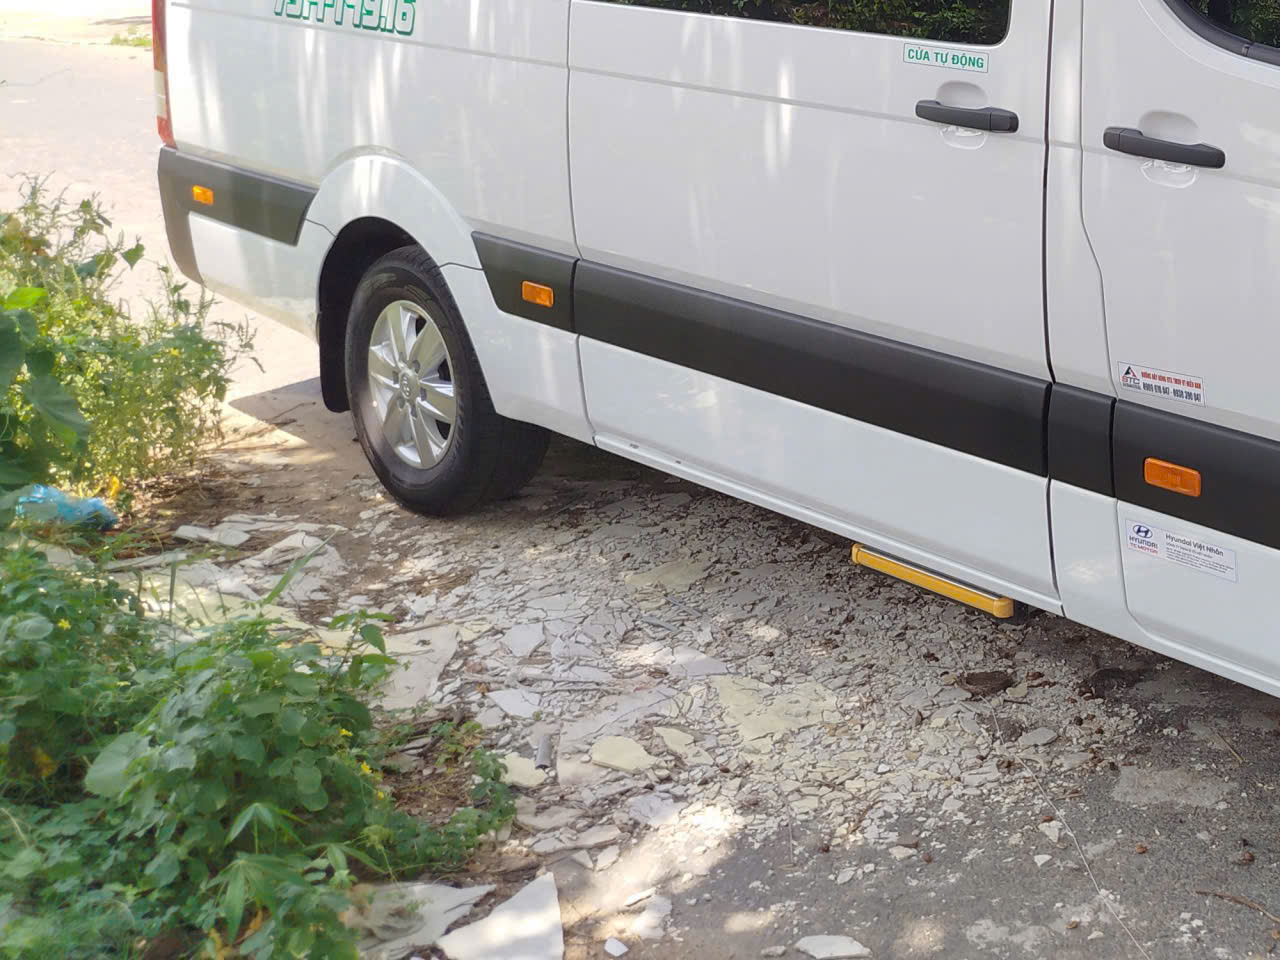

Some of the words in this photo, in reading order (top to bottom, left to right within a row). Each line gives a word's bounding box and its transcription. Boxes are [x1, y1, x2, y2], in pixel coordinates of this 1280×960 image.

[907, 46, 930, 61] CỬA
[934, 51, 949, 65] TỰ
[951, 52, 984, 68] ĐỘNG
[1165, 533, 1192, 547] Hyundai
